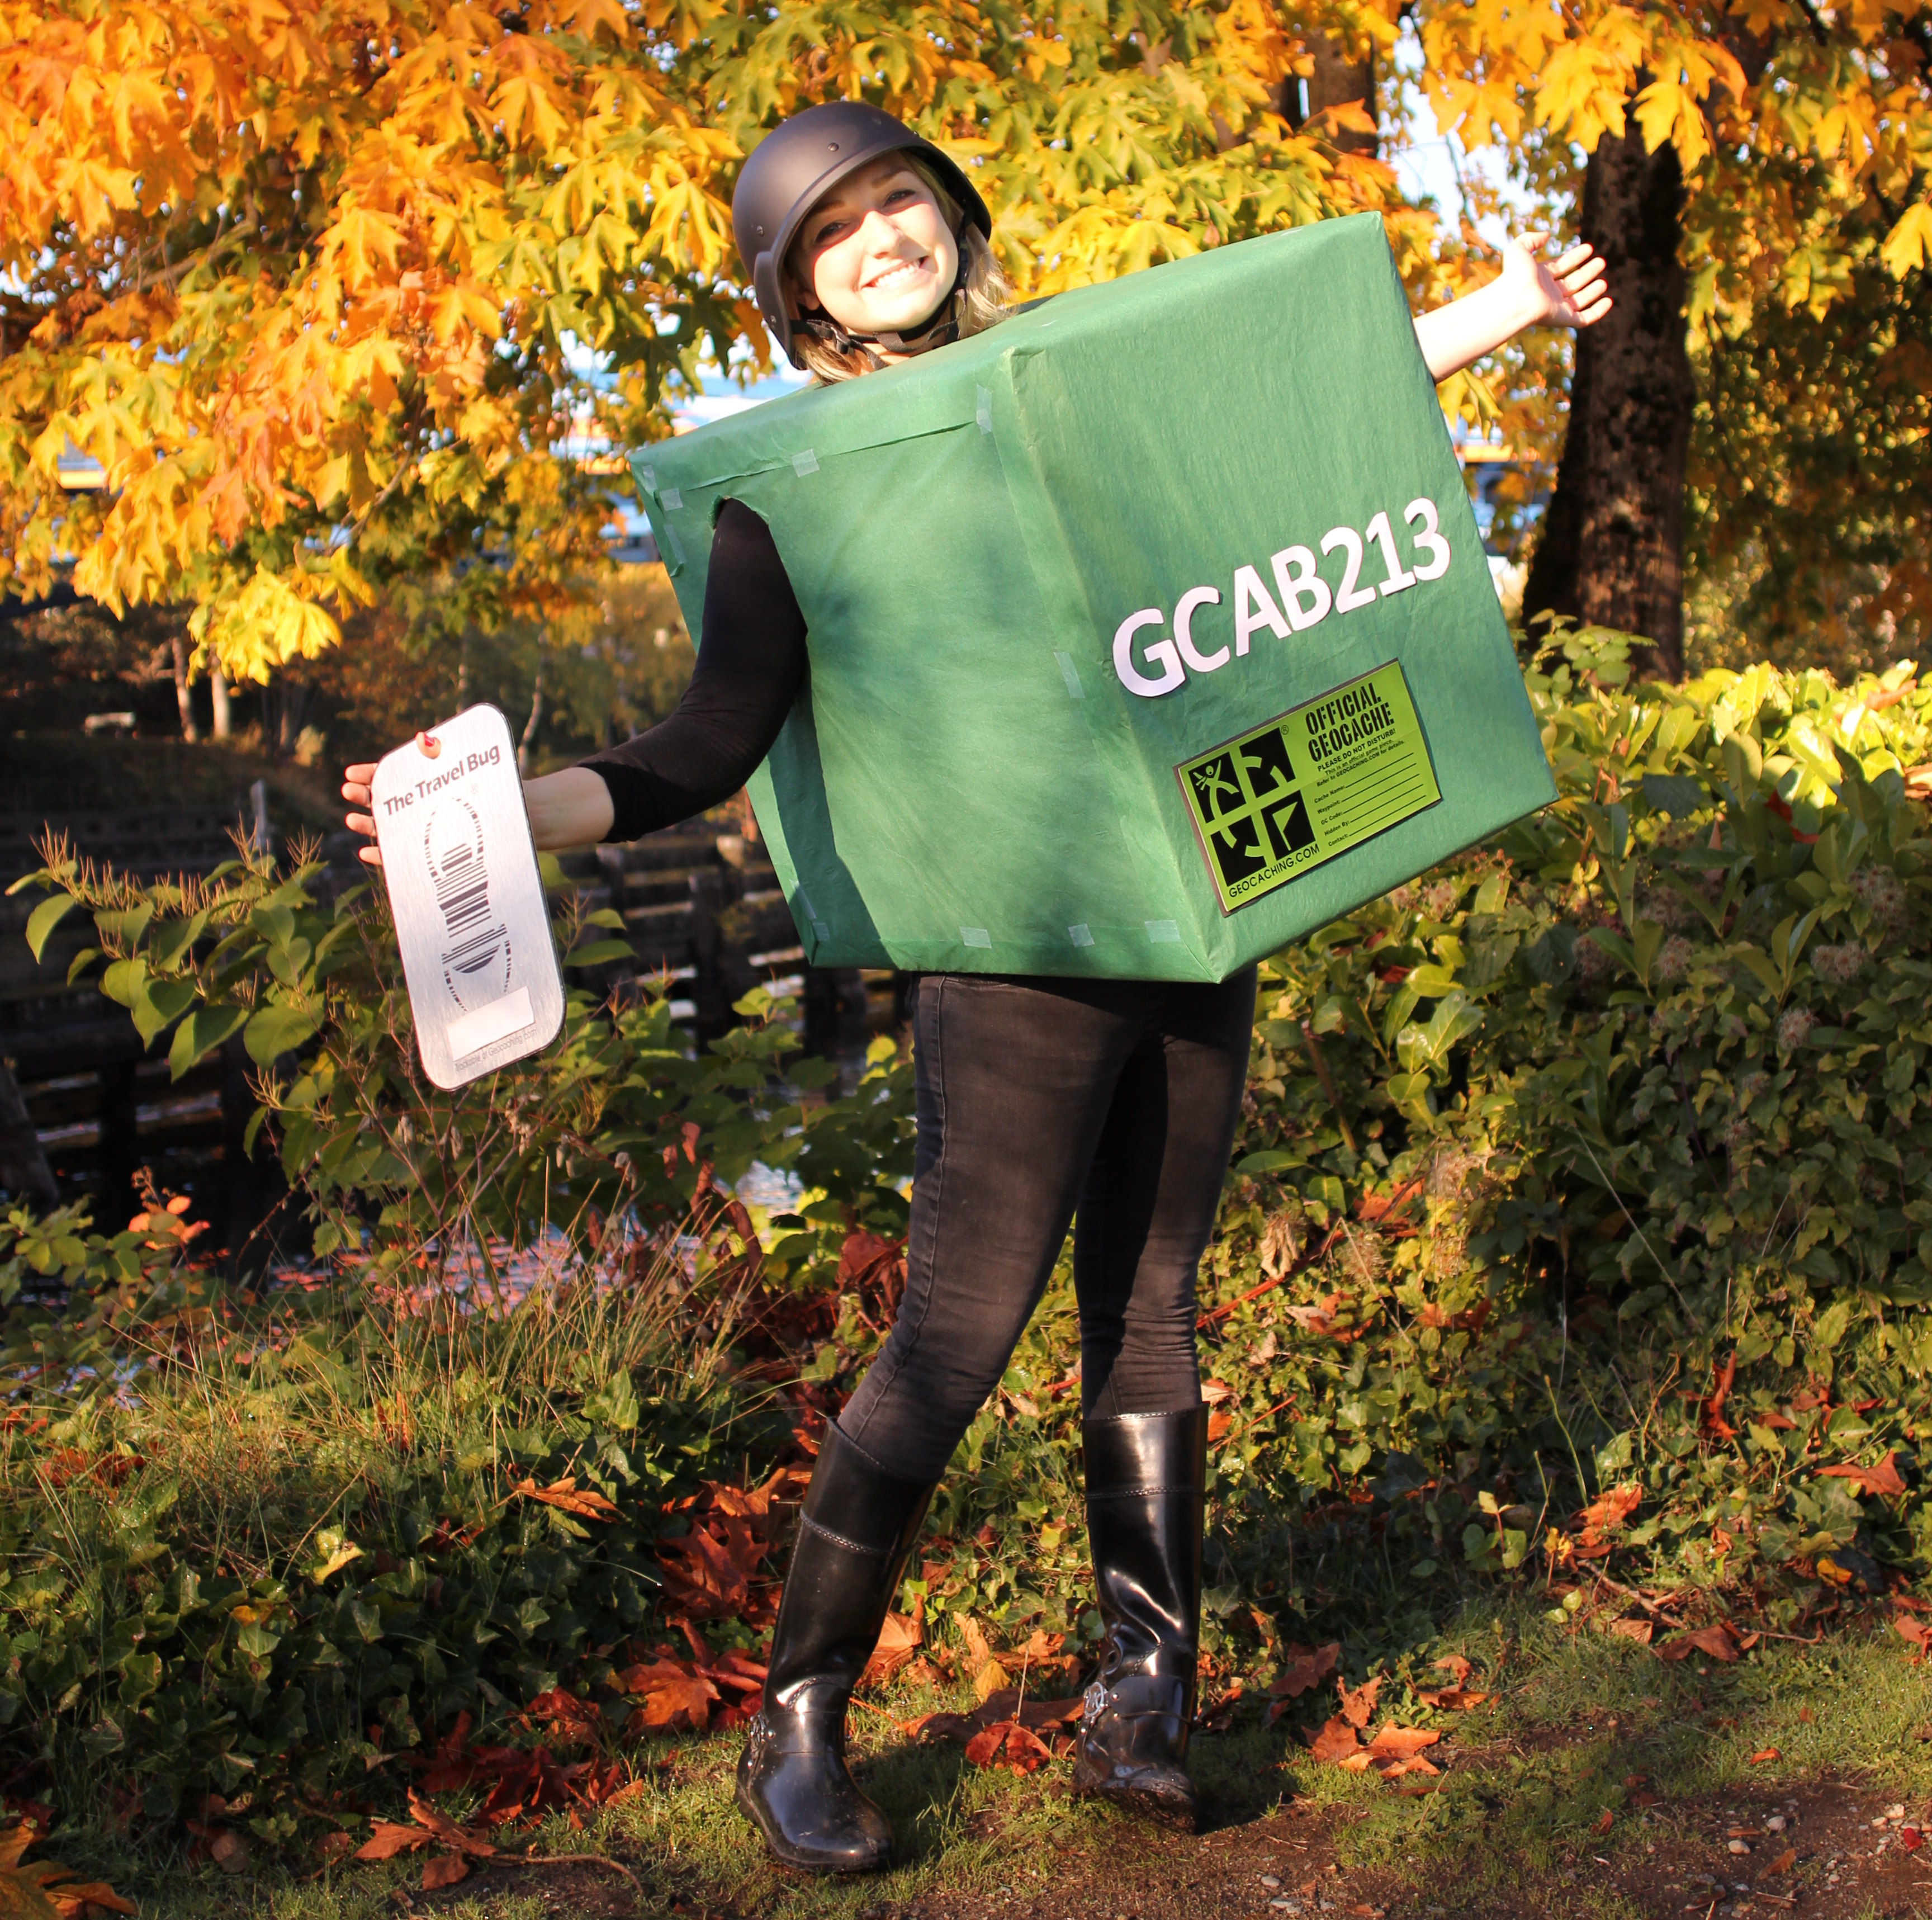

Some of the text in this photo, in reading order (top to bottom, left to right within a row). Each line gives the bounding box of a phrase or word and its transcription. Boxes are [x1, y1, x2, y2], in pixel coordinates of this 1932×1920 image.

[1113, 497, 1452, 697] GCAB213
[1305, 682, 1382, 735] OFFICIAL
[1308, 702, 1394, 762] GEOCACHE
[1318, 728, 1396, 772] PLEASE DO NOT DISTURB!
[1336, 751, 1380, 777] GEOCACHING.COM
[383, 745, 500, 816] The Travel Bug
[1314, 793, 1329, 803] Cache
[1324, 825, 1341, 835] Hidden
[1229, 844, 1320, 897] GEOCACHING.COM
